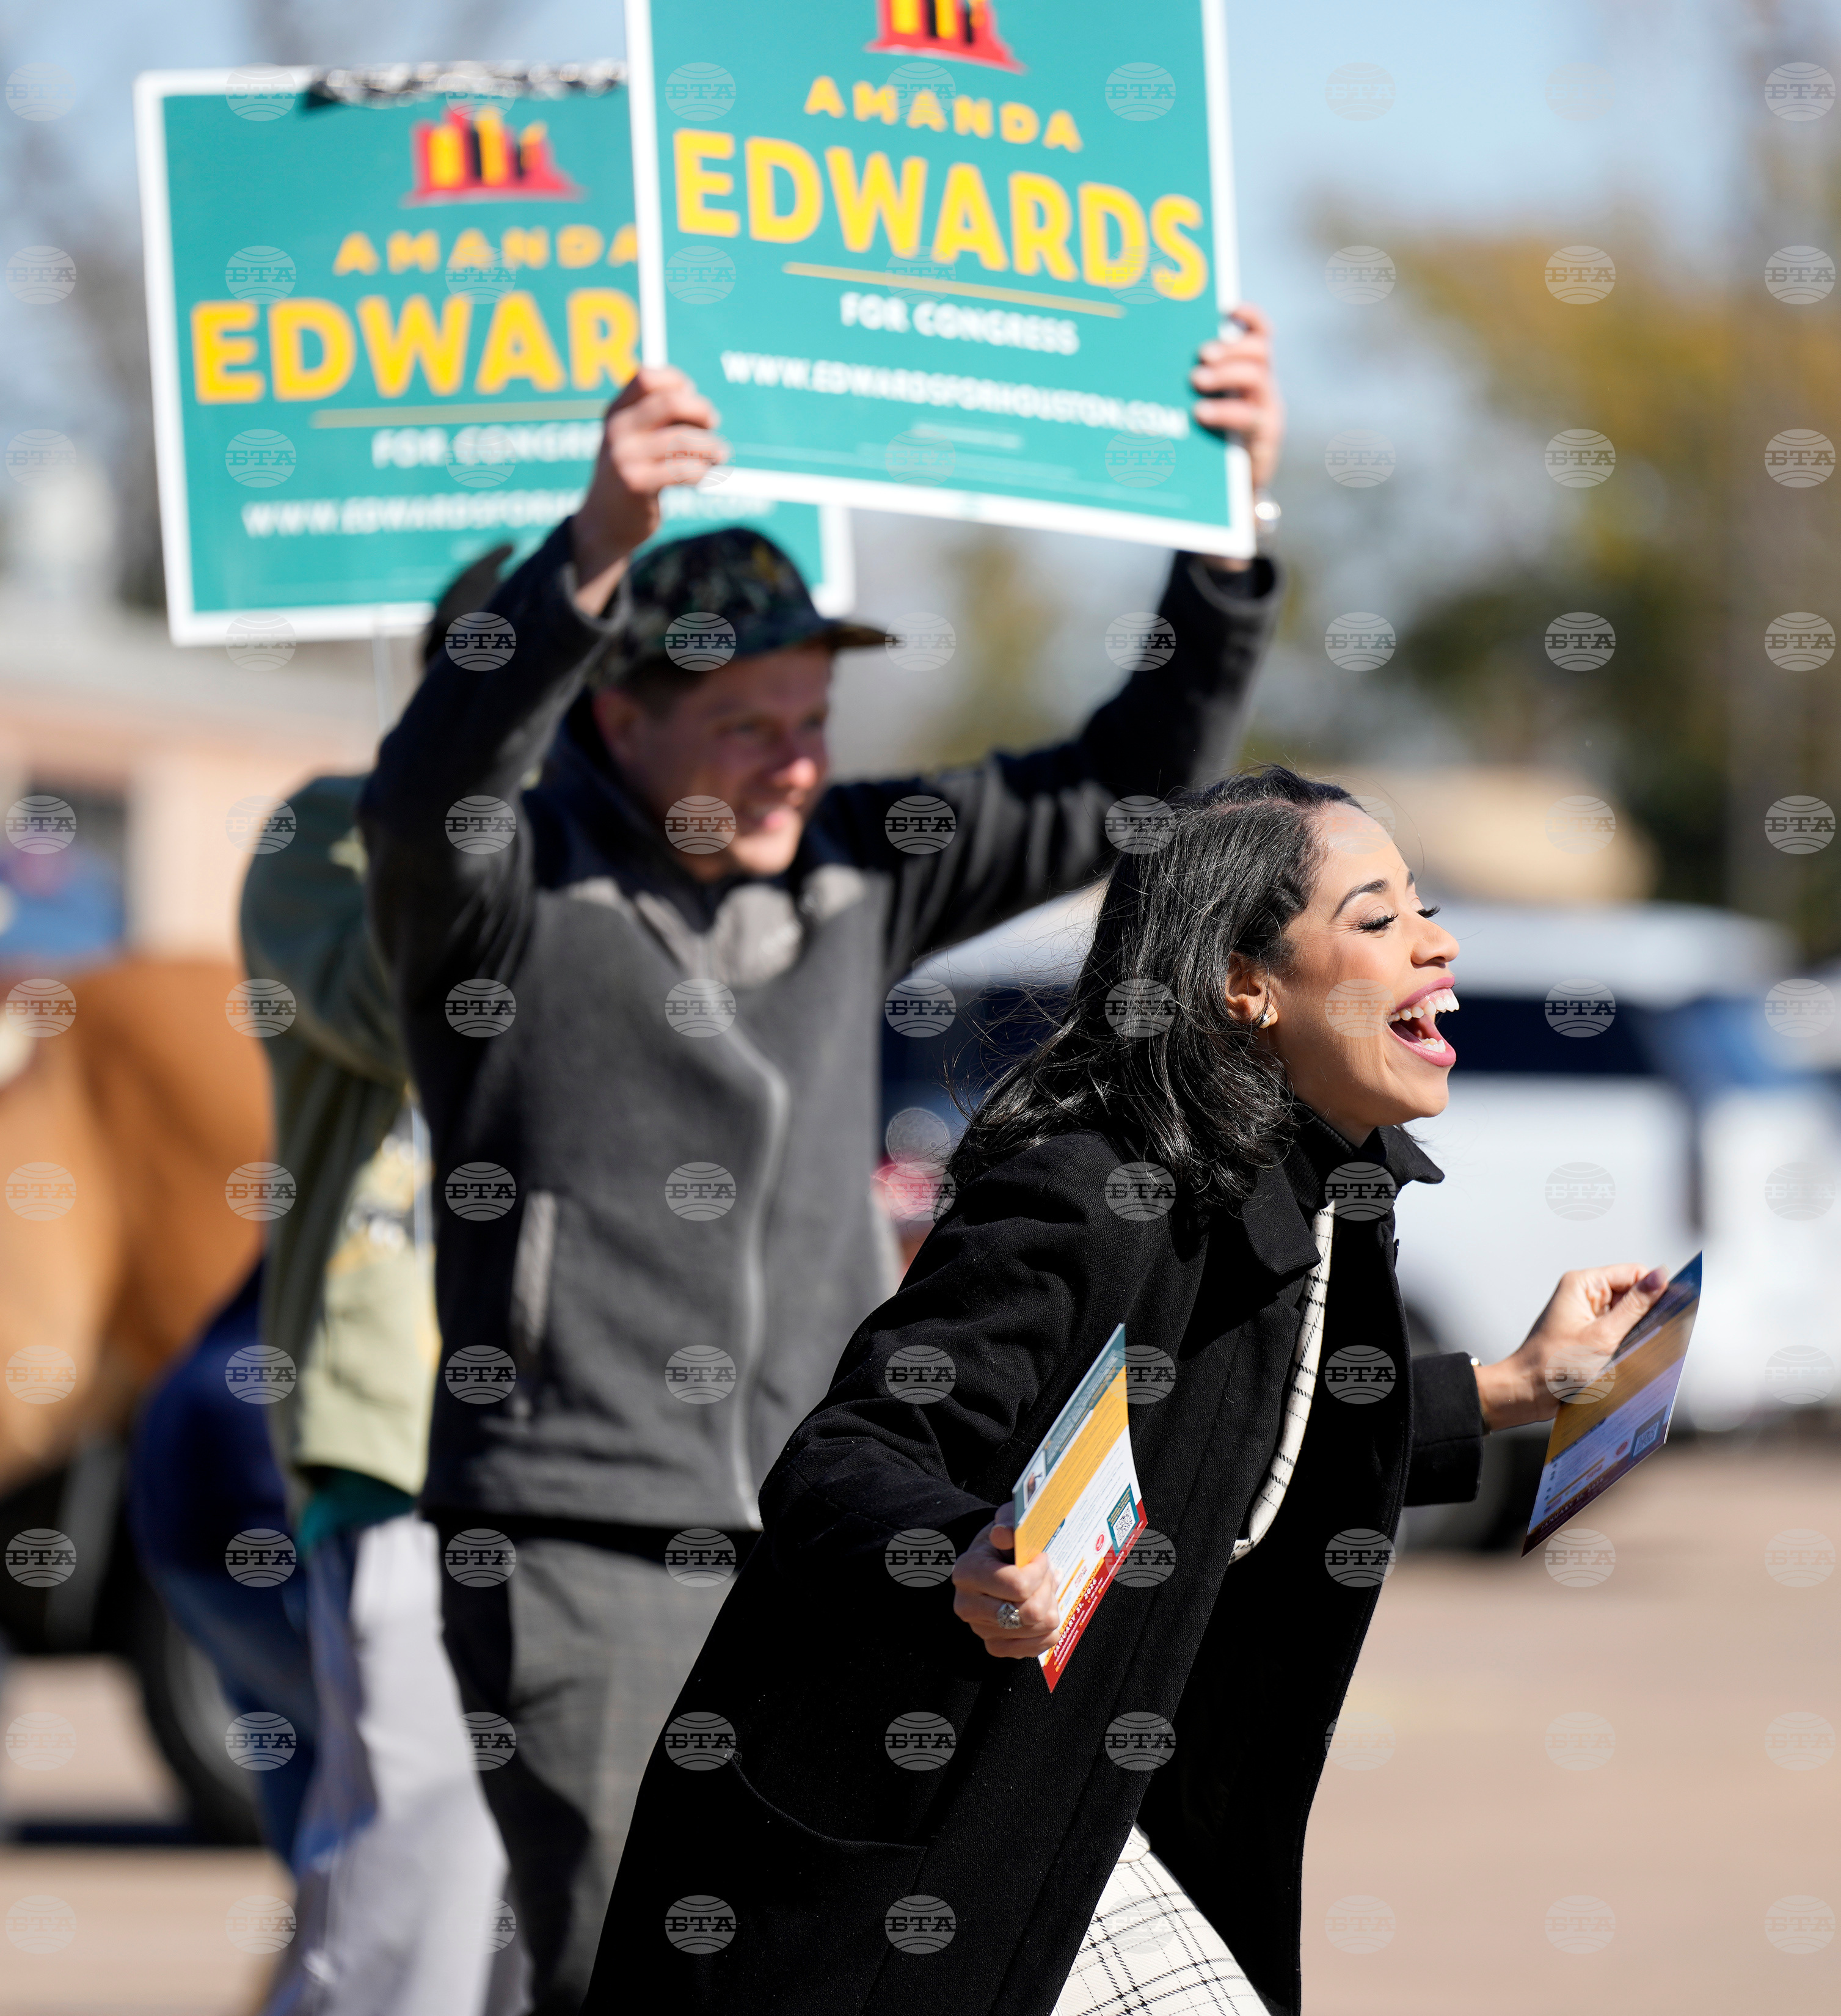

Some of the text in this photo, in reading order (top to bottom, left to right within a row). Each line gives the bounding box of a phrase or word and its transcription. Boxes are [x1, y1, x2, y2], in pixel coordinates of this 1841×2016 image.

[804, 76, 1084, 153] AMANDA
[332, 223, 639, 277] AMANDA
[673, 128, 1208, 302] EDWARDS
[191, 288, 641, 404] EDWAR
[840, 292, 1081, 356] FOR CONGRESS
[720, 350, 1189, 440] WWW.EDWARDSFORHOUSTON.COM
[371, 428, 448, 469] FOR
[1054, 1613, 1076, 1657] JANUARY
[1084, 1578, 1097, 1600] 2026
